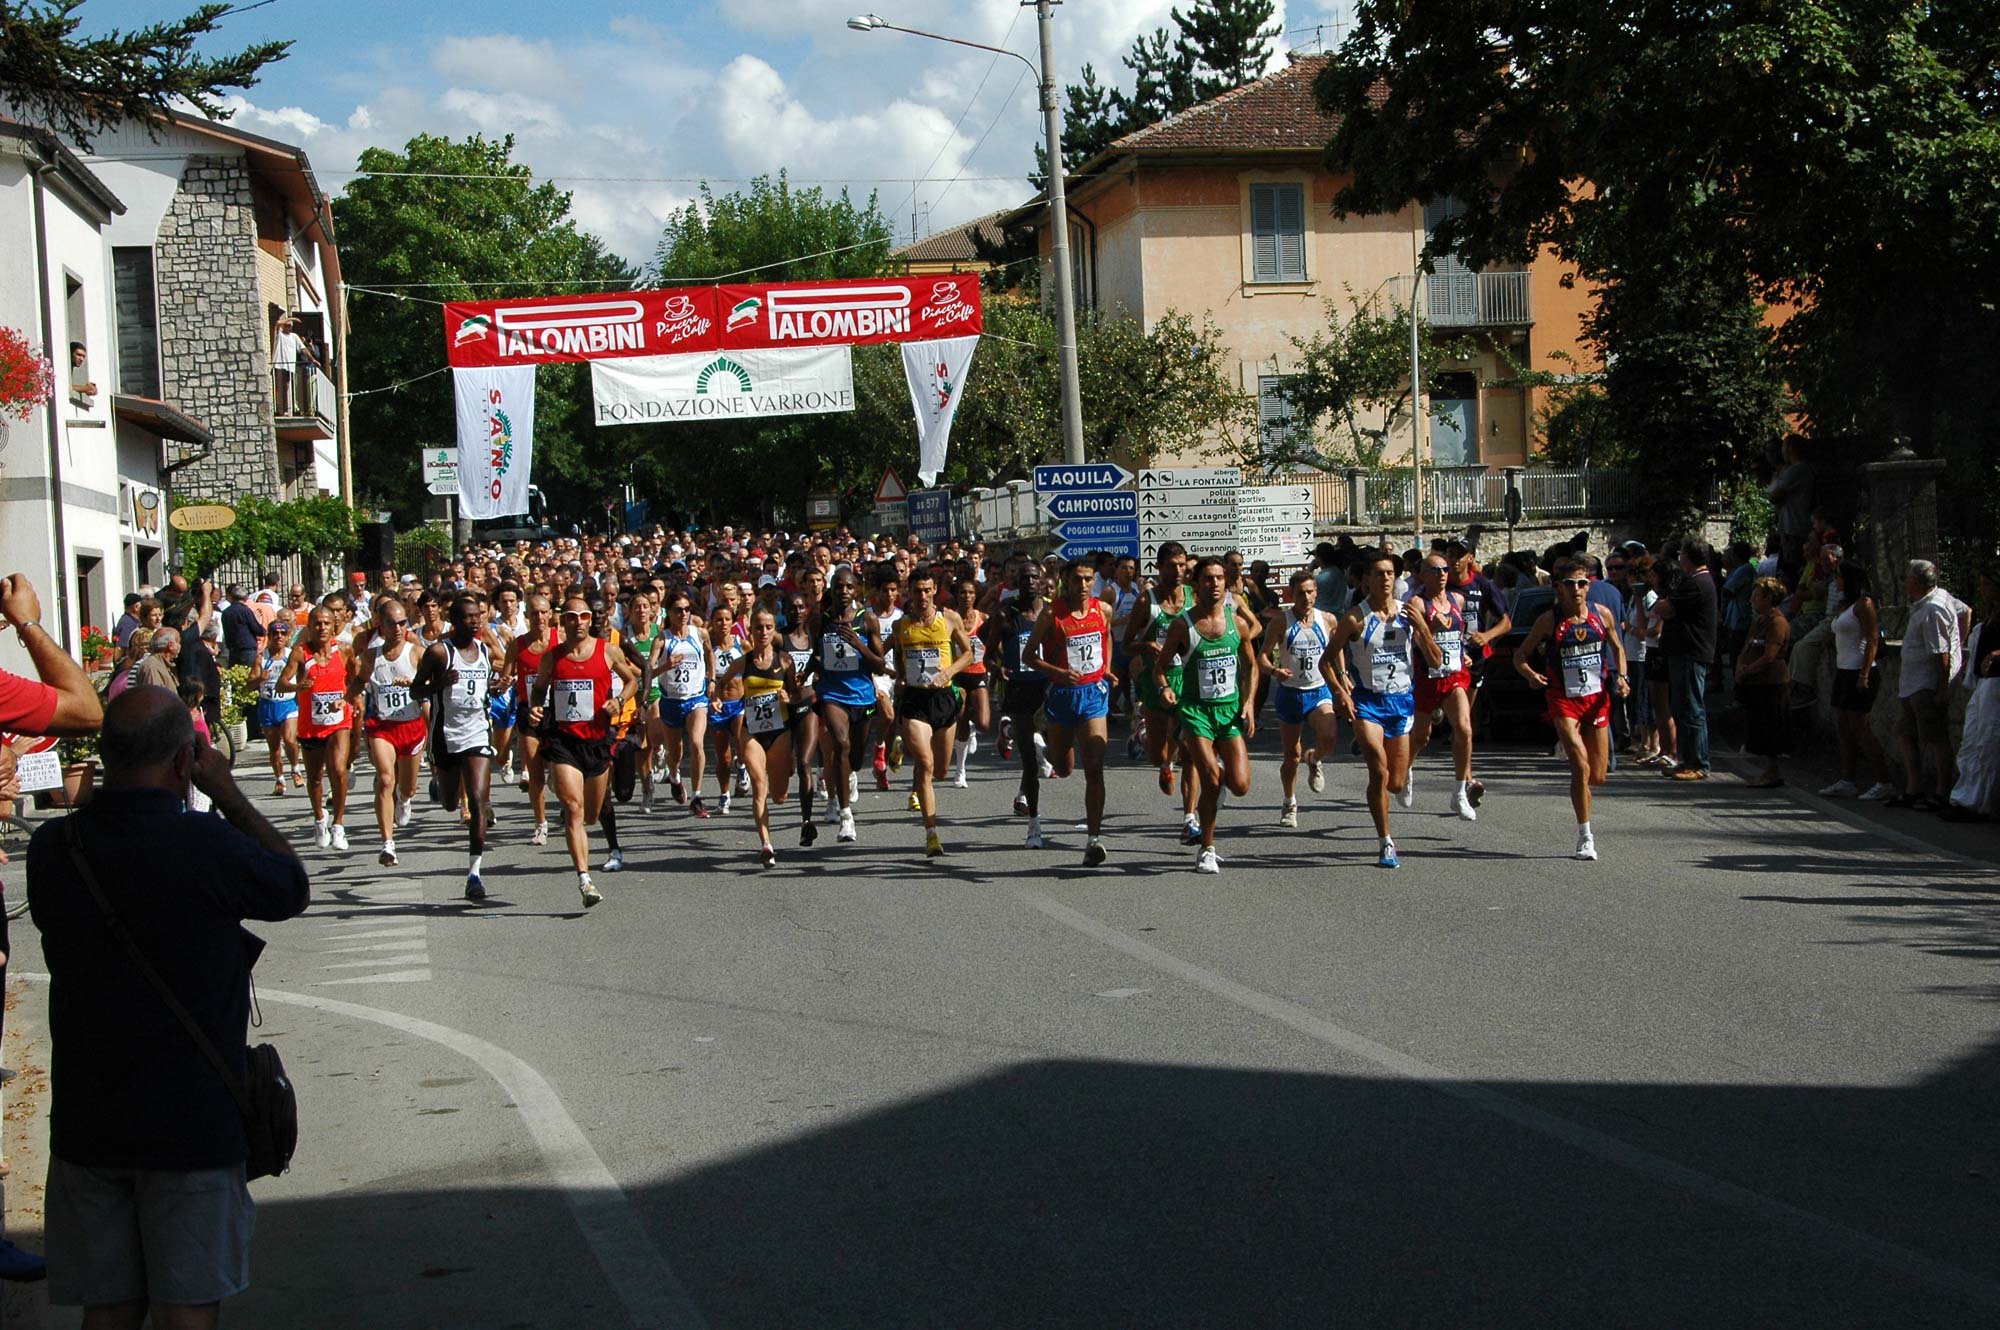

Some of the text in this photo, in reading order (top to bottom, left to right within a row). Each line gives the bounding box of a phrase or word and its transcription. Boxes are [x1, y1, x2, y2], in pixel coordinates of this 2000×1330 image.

[767, 286, 911, 339] PALOMBINI
[921, 302, 964, 320] Piacere
[495, 301, 645, 356] PALOMBINI
[656, 315, 700, 337] Piacere
[935, 319, 948, 327] di
[671, 333, 683, 344] di
[936, 362, 951, 409] SA
[600, 390, 851, 421] FONDAZIONE VARRONE
[490, 389, 502, 500] SANO
[1210, 489, 1236, 497] polizia
[1058, 498, 1134, 512] CAMPOTOSTO
[1238, 506, 1273, 515] palazzetto
[1188, 512, 1237, 521] castagneto
[916, 527, 947, 539] AMPOTOSTO
[1067, 525, 1129, 535] POGGIO CANCELLI
[1181, 529, 1233, 538] campagnola
[1260, 525, 1291, 533] forestale
[1258, 534, 1278, 542] Stato
[1067, 547, 1103, 556] CORNO
[1190, 544, 1237, 552] Giovannino
[1068, 634, 1100, 646] Reebok
[836, 644, 844, 658] 3
[1078, 644, 1094, 662] 12
[1443, 650, 1450, 666] 6
[1201, 658, 1235, 669] Reebok
[1298, 656, 1312, 670] 16
[674, 670, 690, 683] 23
[1209, 668, 1226, 685] 13
[1388, 664, 1396, 679] 2
[1579, 668, 1588, 684] 5
[467, 680, 476, 695] 9
[556, 681, 590, 690] Reebok
[384, 692, 408, 708] 181
[568, 692, 578, 707] 4
[754, 705, 773, 720] 25
